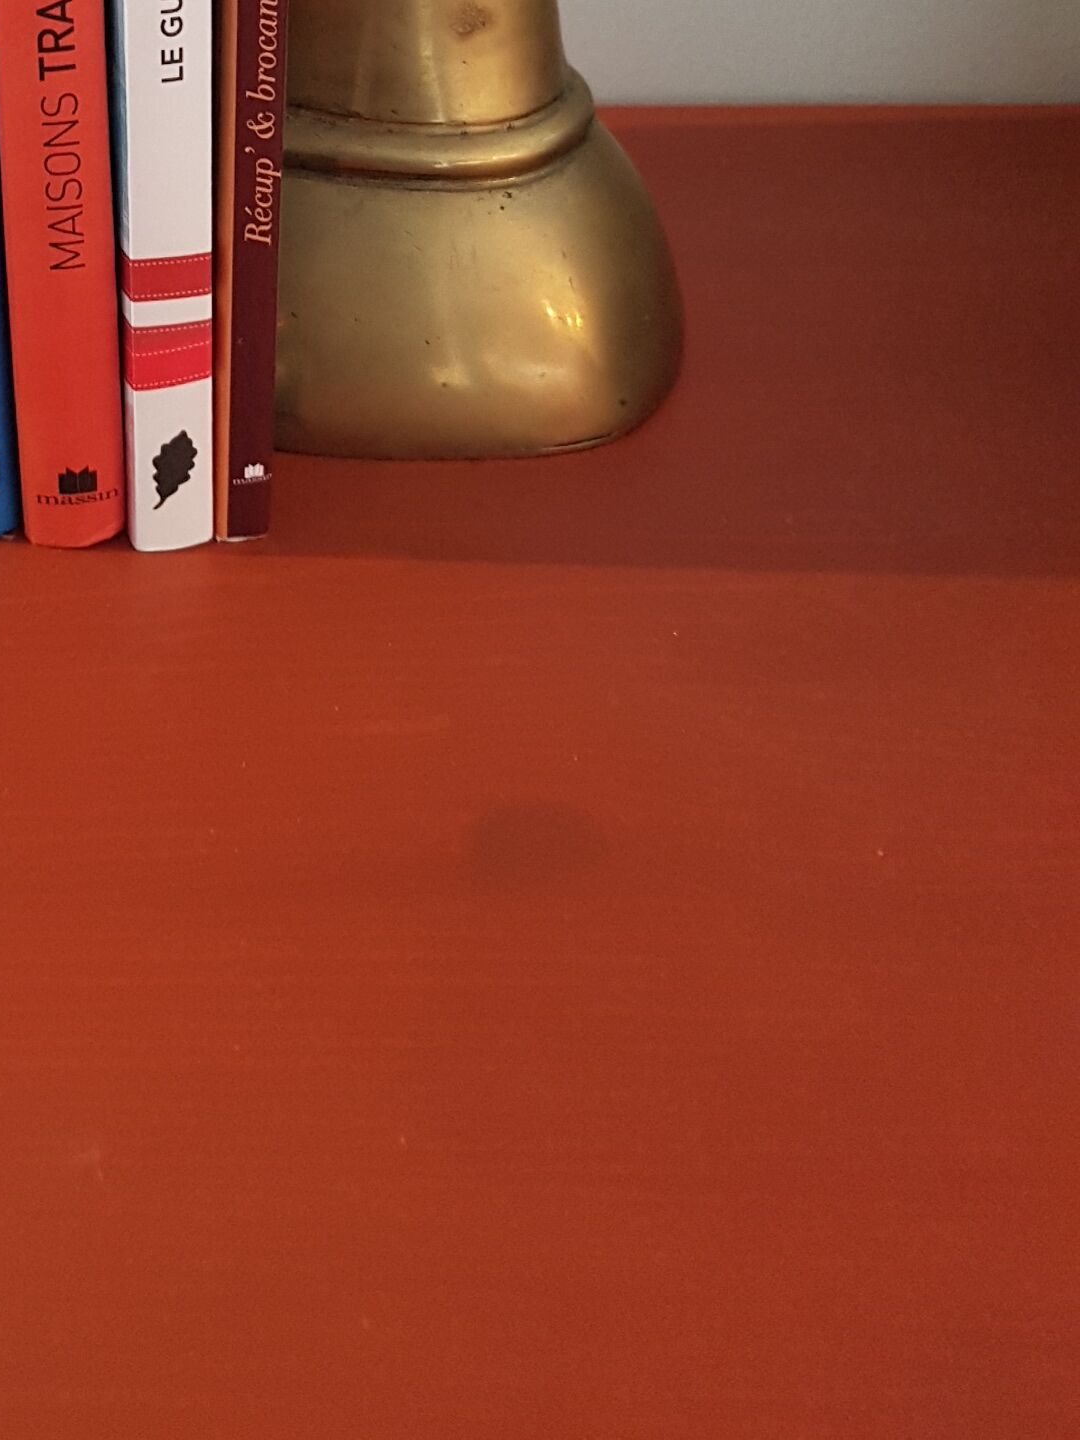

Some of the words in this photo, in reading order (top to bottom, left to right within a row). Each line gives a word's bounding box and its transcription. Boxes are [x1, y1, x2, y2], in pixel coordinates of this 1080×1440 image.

[161, 46, 184, 84] LE
[245, 111, 276, 141] &
[39, 91, 87, 272] MAISONS
[35, 485, 119, 507] massin
